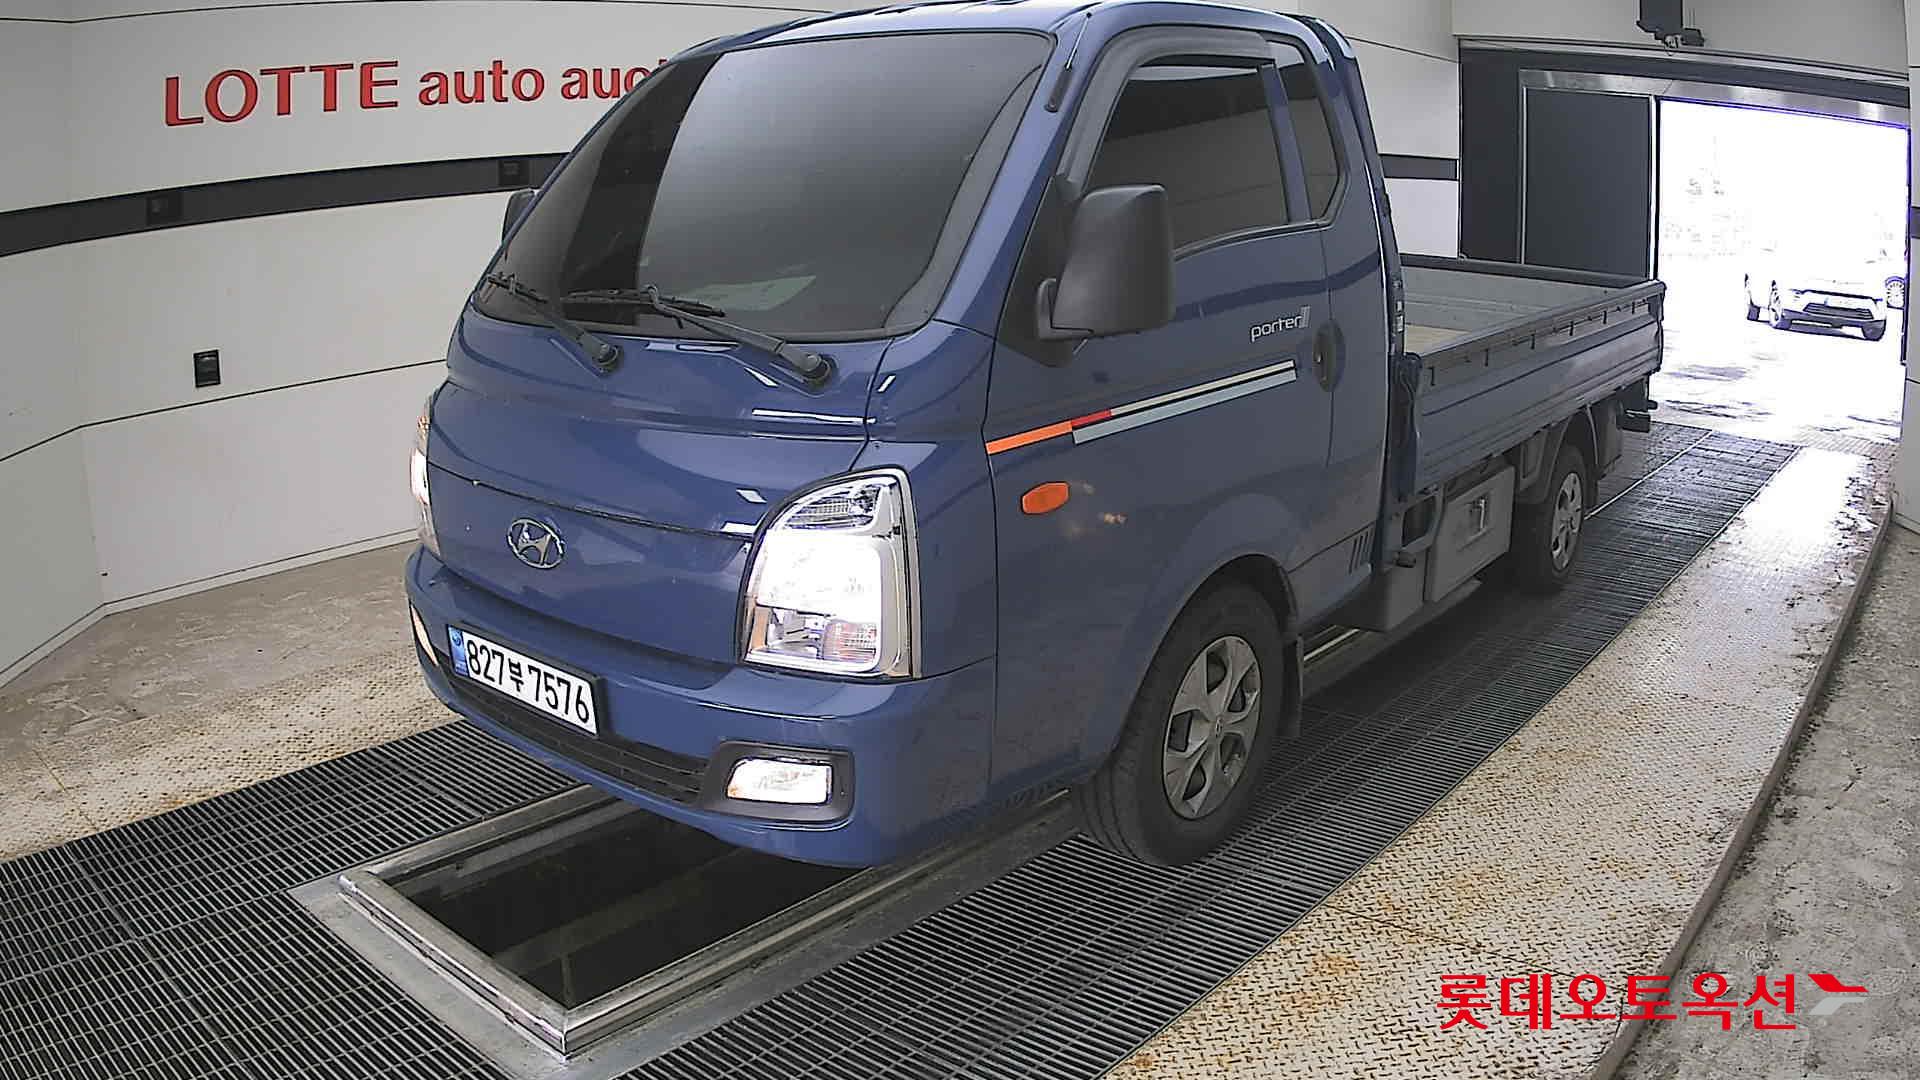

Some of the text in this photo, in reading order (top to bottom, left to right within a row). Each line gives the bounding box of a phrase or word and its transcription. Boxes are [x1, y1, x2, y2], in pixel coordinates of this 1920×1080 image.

[165, 58, 667, 126] LOTTE auto auc
